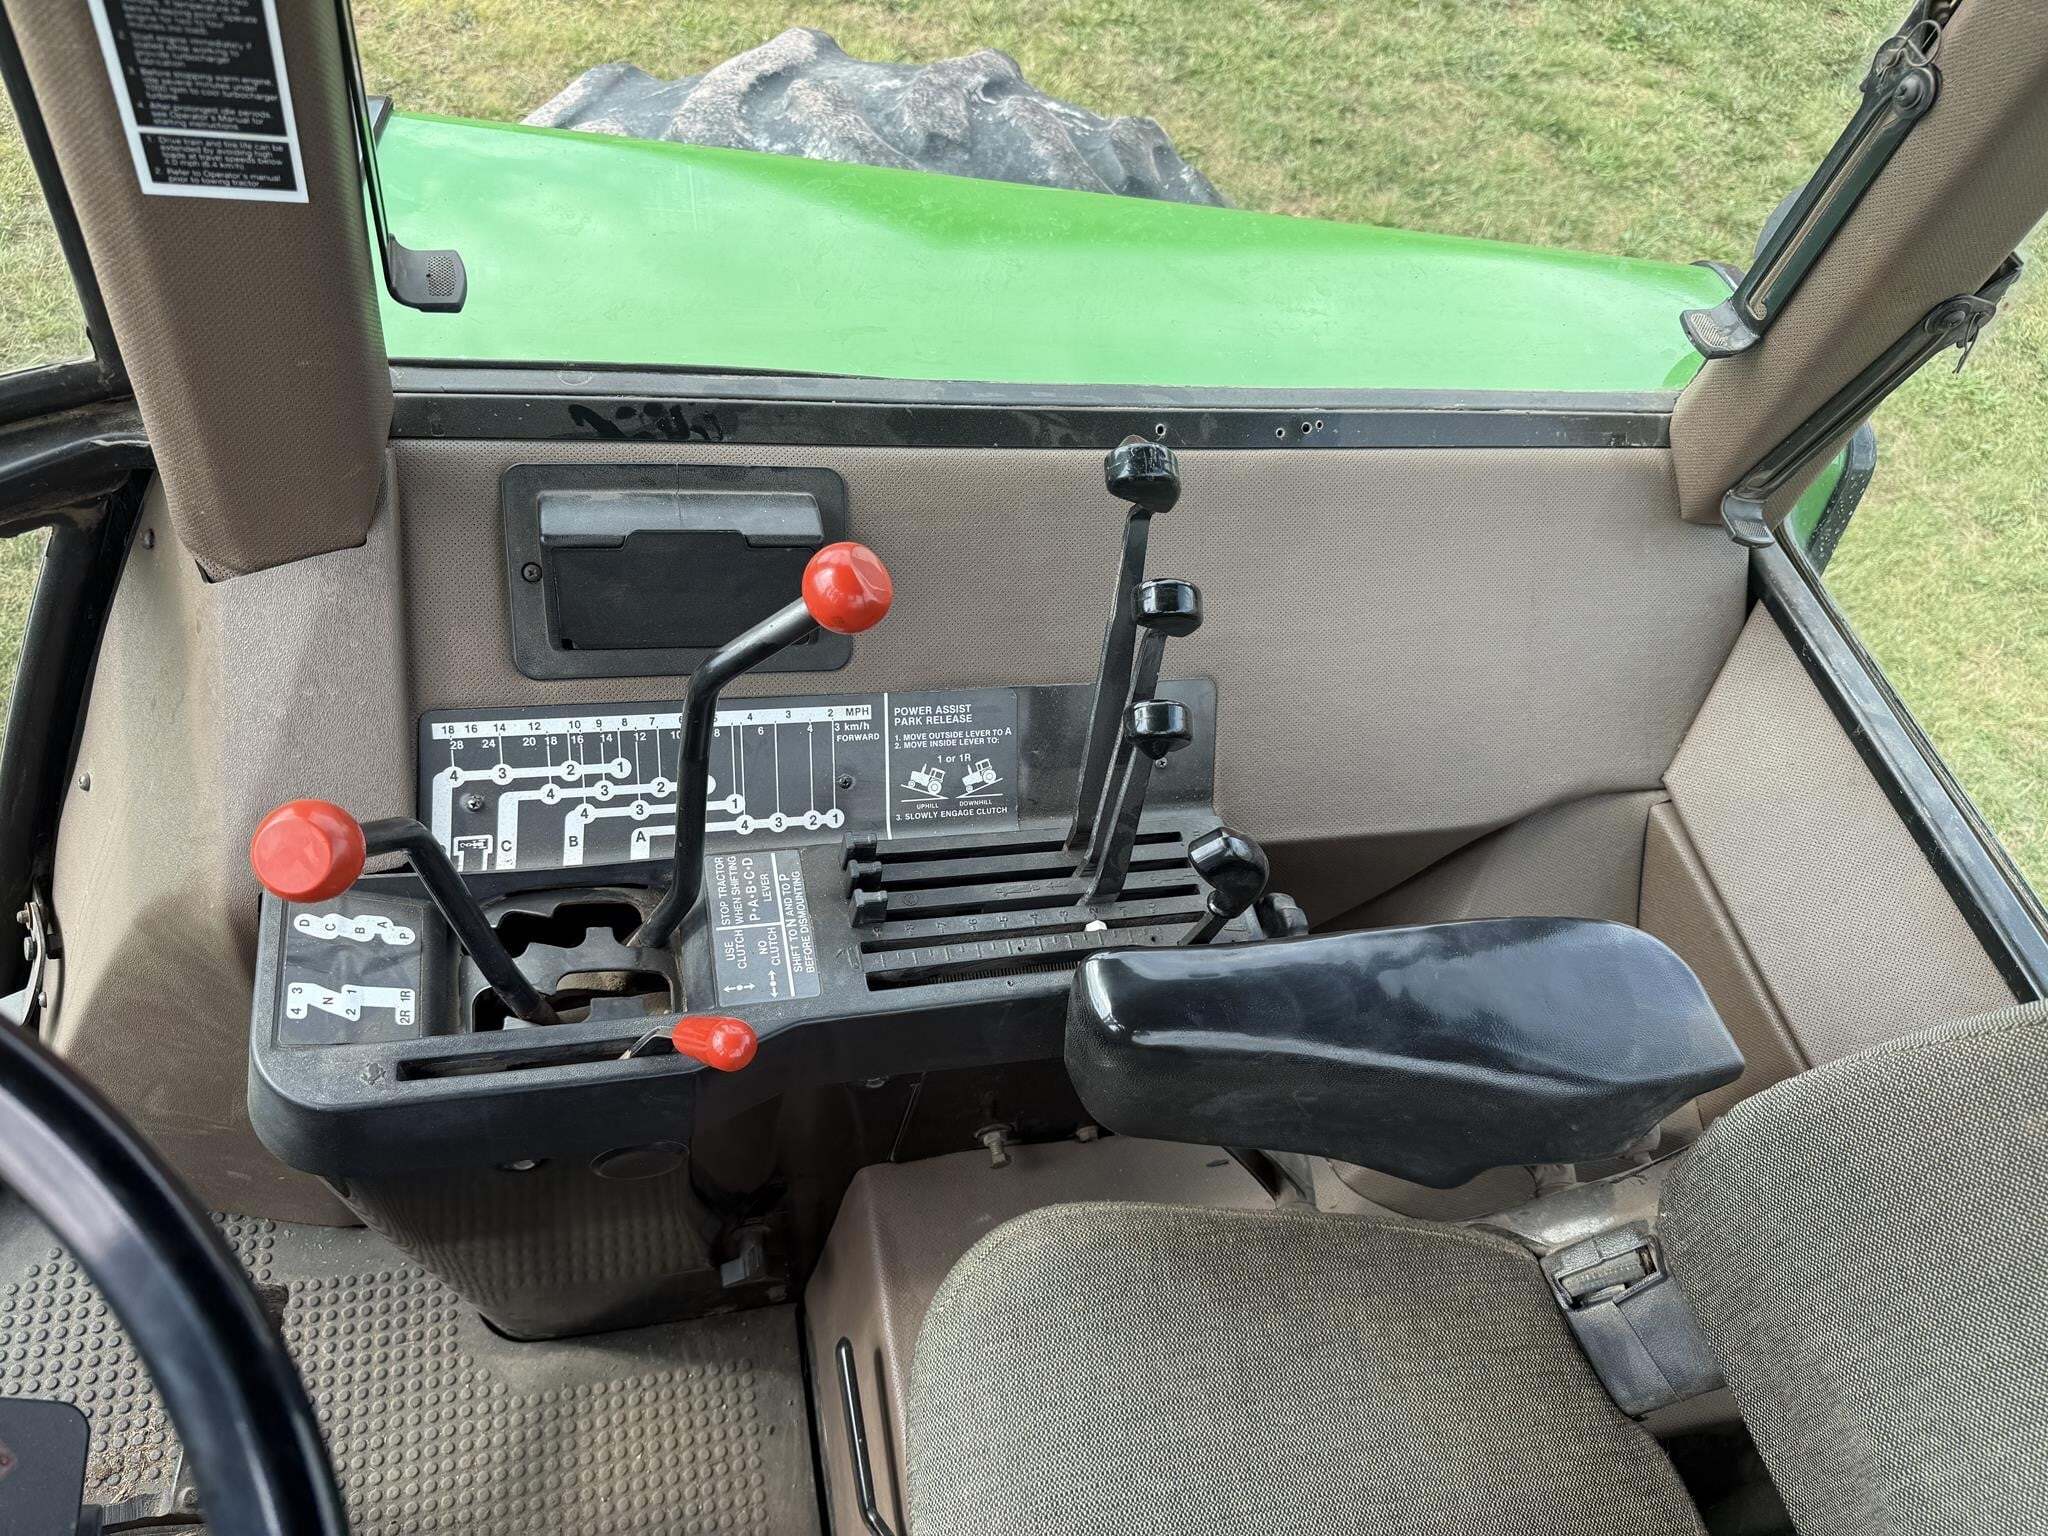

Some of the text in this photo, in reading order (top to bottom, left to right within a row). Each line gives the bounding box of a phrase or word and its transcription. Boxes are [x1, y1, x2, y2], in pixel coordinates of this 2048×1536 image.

[894, 704, 972, 716] POWER ASSIST
[441, 725, 455, 735] 18
[465, 724, 478, 733] 16
[493, 723, 506, 732] 14
[528, 722, 541, 731] 12
[569, 720, 581, 729] 10
[596, 719, 602, 728] 9
[622, 718, 627, 727] 8
[650, 717, 655, 726] 7
[747, 712, 753, 721] 4
[785, 710, 791, 719] 3
[828, 709, 834, 718] 2
[845, 707, 869, 717] MPH
[894, 714, 973, 726] PARK RELEASE
[449, 740, 464, 750] 28
[482, 739, 496, 748] 24
[522, 737, 536, 746] 20
[544, 736, 558, 746] 18
[571, 735, 584, 745] 16
[600, 734, 613, 743] 14
[634, 733, 647, 742] 12
[714, 728, 720, 738] 8
[758, 727, 764, 736] 6
[807, 725, 813, 733] 4
[834, 723, 840, 731] 3
[844, 721, 870, 732] km/h
[836, 733, 879, 742] FORWARD
[903, 733, 927, 741] MOVE
[929, 731, 964, 740] OUTSIDE
[965, 730, 991, 738] LEVER
[1004, 727, 1012, 736] A
[903, 741, 927, 749] MOVE
[930, 740, 957, 748] INSIDE
[959, 738, 985, 746] LEVER
[937, 755, 942, 763] 1
[959, 753, 972, 762] 1R
[450, 763, 623, 781] 4 3 2 1
[546, 782, 665, 798] 4 3 2
[580, 799, 738, 818] 4 3 1
[904, 811, 938, 821] SLOWLY
[940, 809, 974, 818] ENGAGE
[976, 807, 1008, 815] CLUTCH
[741, 814, 838, 830] 4 3 2 1
[569, 837, 578, 847] B
[636, 832, 646, 842] A
[501, 840, 512, 852] C
[714, 857, 731, 926] STOP TRACTOR
[727, 855, 744, 925] WHEN SHIFTING
[760, 873, 773, 902] LEVER
[299, 919, 310, 927] D
[325, 923, 336, 931] C
[377, 921, 387, 929] A
[399, 932, 410, 940] P
[779, 873, 803, 973] SHIFT TO N AND TO P
[791, 871, 816, 974] BEFORE DISMOUNTING
[724, 941, 736, 961] USE
[734, 930, 748, 970] CLUTCH
[758, 940, 769, 955] NO
[767, 927, 781, 966] CLUTCH
[323, 997, 333, 1005] N
[400, 990, 411, 1002] 1R
[291, 1007, 411, 1024] 4 2 2R
